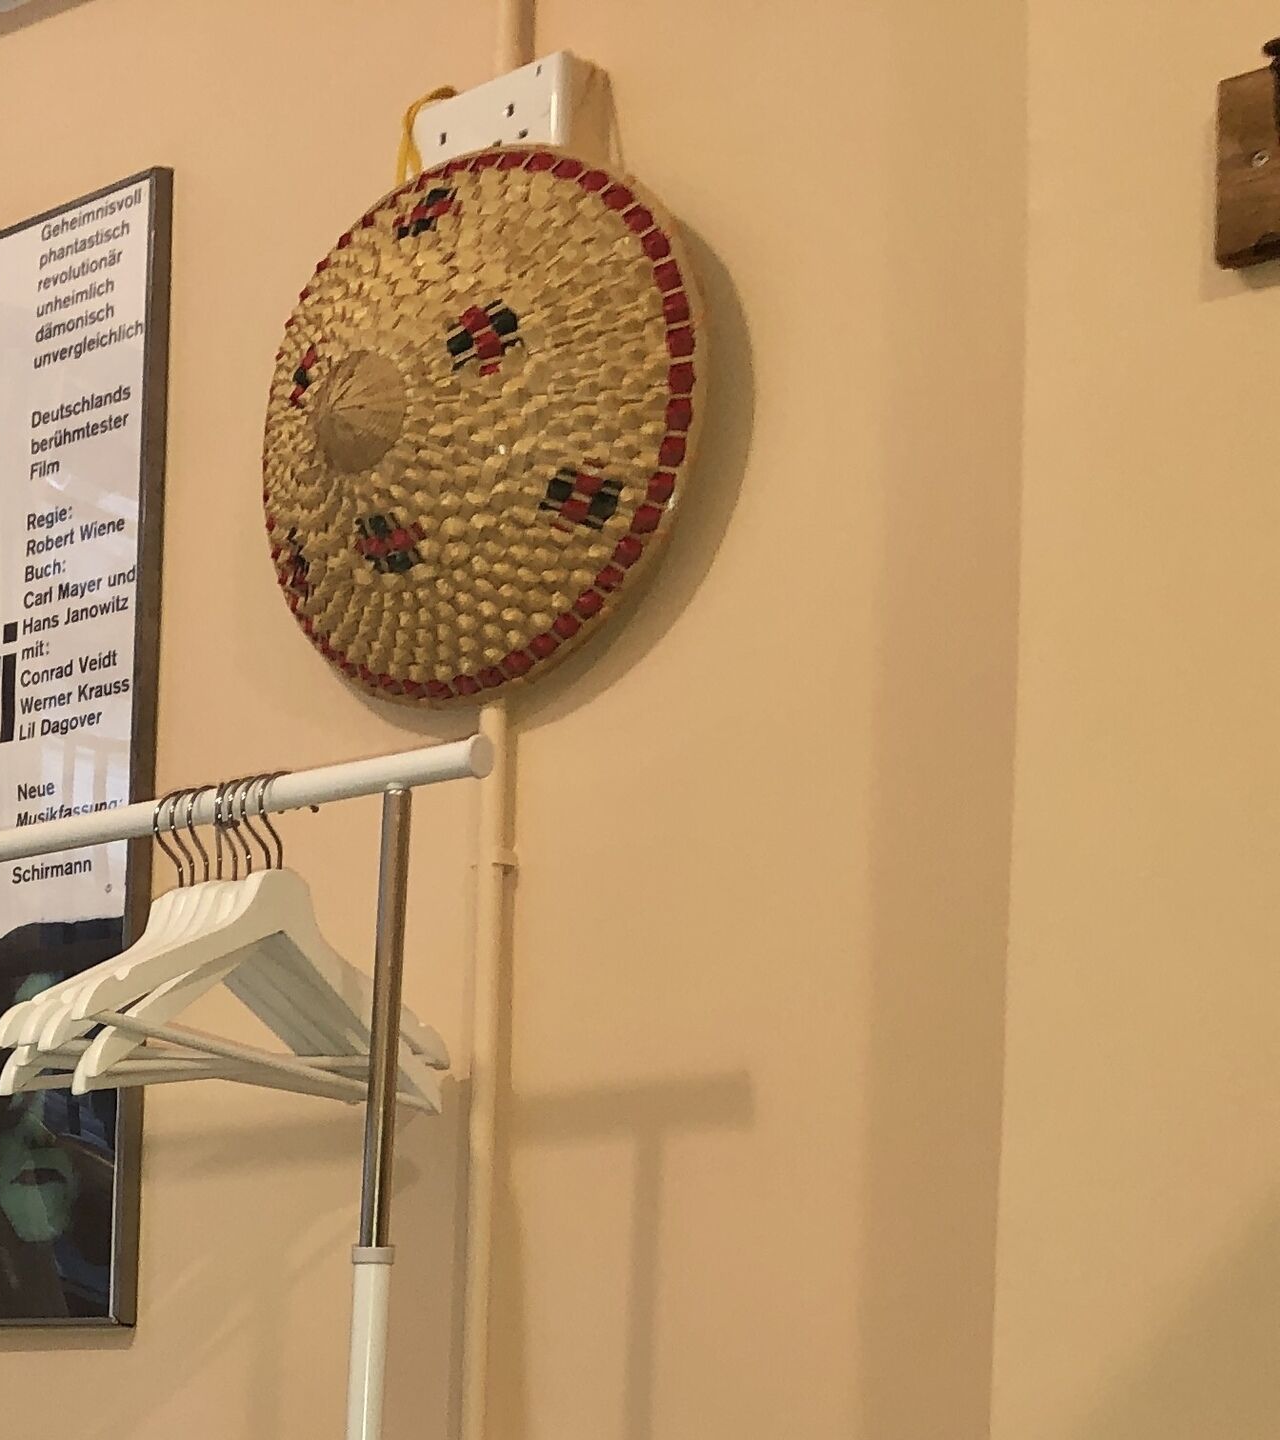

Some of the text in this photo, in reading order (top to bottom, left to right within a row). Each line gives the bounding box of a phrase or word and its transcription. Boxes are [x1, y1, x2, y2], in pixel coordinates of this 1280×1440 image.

[41, 188, 142, 241] Geheimnisvoll
[39, 220, 130, 270] phantastisch
[38, 249, 123, 292] revolutionär
[36, 278, 115, 317] unheimlich
[35, 303, 115, 342] dämonisch
[33, 319, 144, 369] unvergleichlich
[31, 385, 131, 428] Deutschlands
[31, 413, 129, 454] berühmtester
[30, 460, 60, 480] Film
[26, 518, 125, 557] Robert Wiene
[27, 506, 72, 531] Regie:
[24, 565, 136, 609] Carl Mayer und
[25, 559, 66, 583] Buch:
[22, 595, 129, 635] Hans Janowitz
[20, 650, 117, 688] Conrad Veidt
[21, 640, 50, 660] mit:
[20, 677, 130, 715] Werner Krauss
[19, 710, 102, 741] Lil Dagover
[17, 782, 55, 802] Neue
[12, 859, 92, 884] Schirmann
